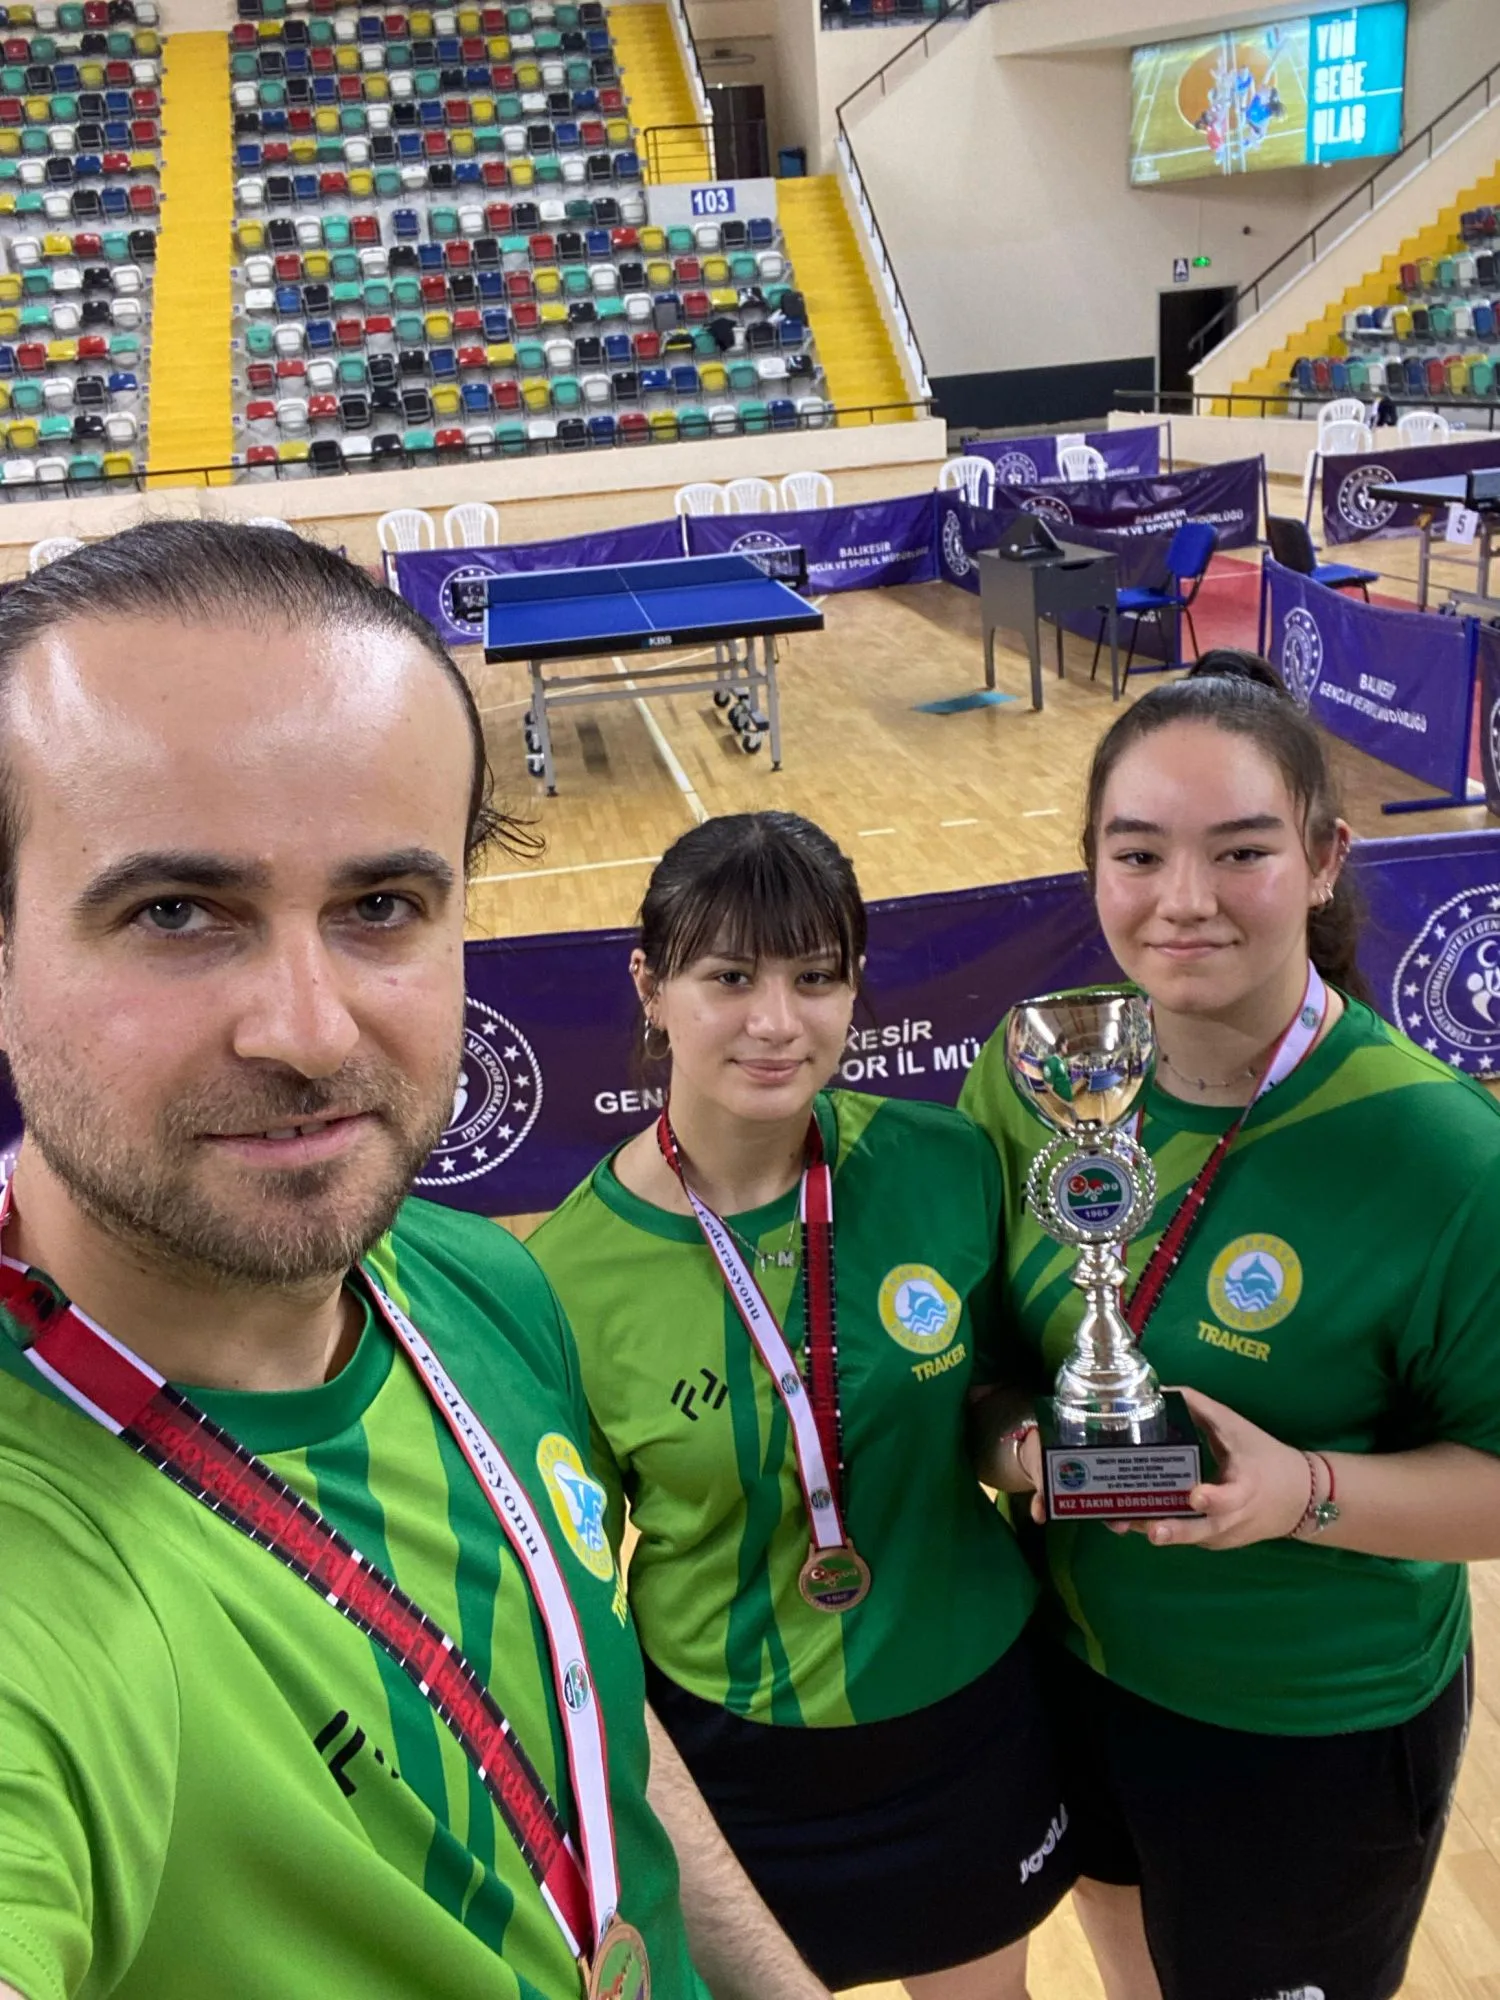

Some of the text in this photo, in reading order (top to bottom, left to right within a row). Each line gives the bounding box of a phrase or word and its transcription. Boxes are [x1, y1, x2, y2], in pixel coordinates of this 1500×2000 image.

[694, 189, 729, 213] 103
[1456, 514, 1467, 534] 5
[839, 541, 891, 558] BALIKESİR
[468, 1038, 486, 1056] VE
[481, 1053, 504, 1083] SPOR
[595, 1037, 982, 1114] GEN OR İL MÜ
[698, 1210, 761, 1321] Federasyonu
[1198, 1320, 1271, 1362] TRAKER
[911, 1343, 966, 1382] TRAKER
[421, 1351, 539, 1557] Federasyonu
[1059, 1499, 1077, 1509] KIZ
[1081, 1497, 1113, 1508] TAKIM
